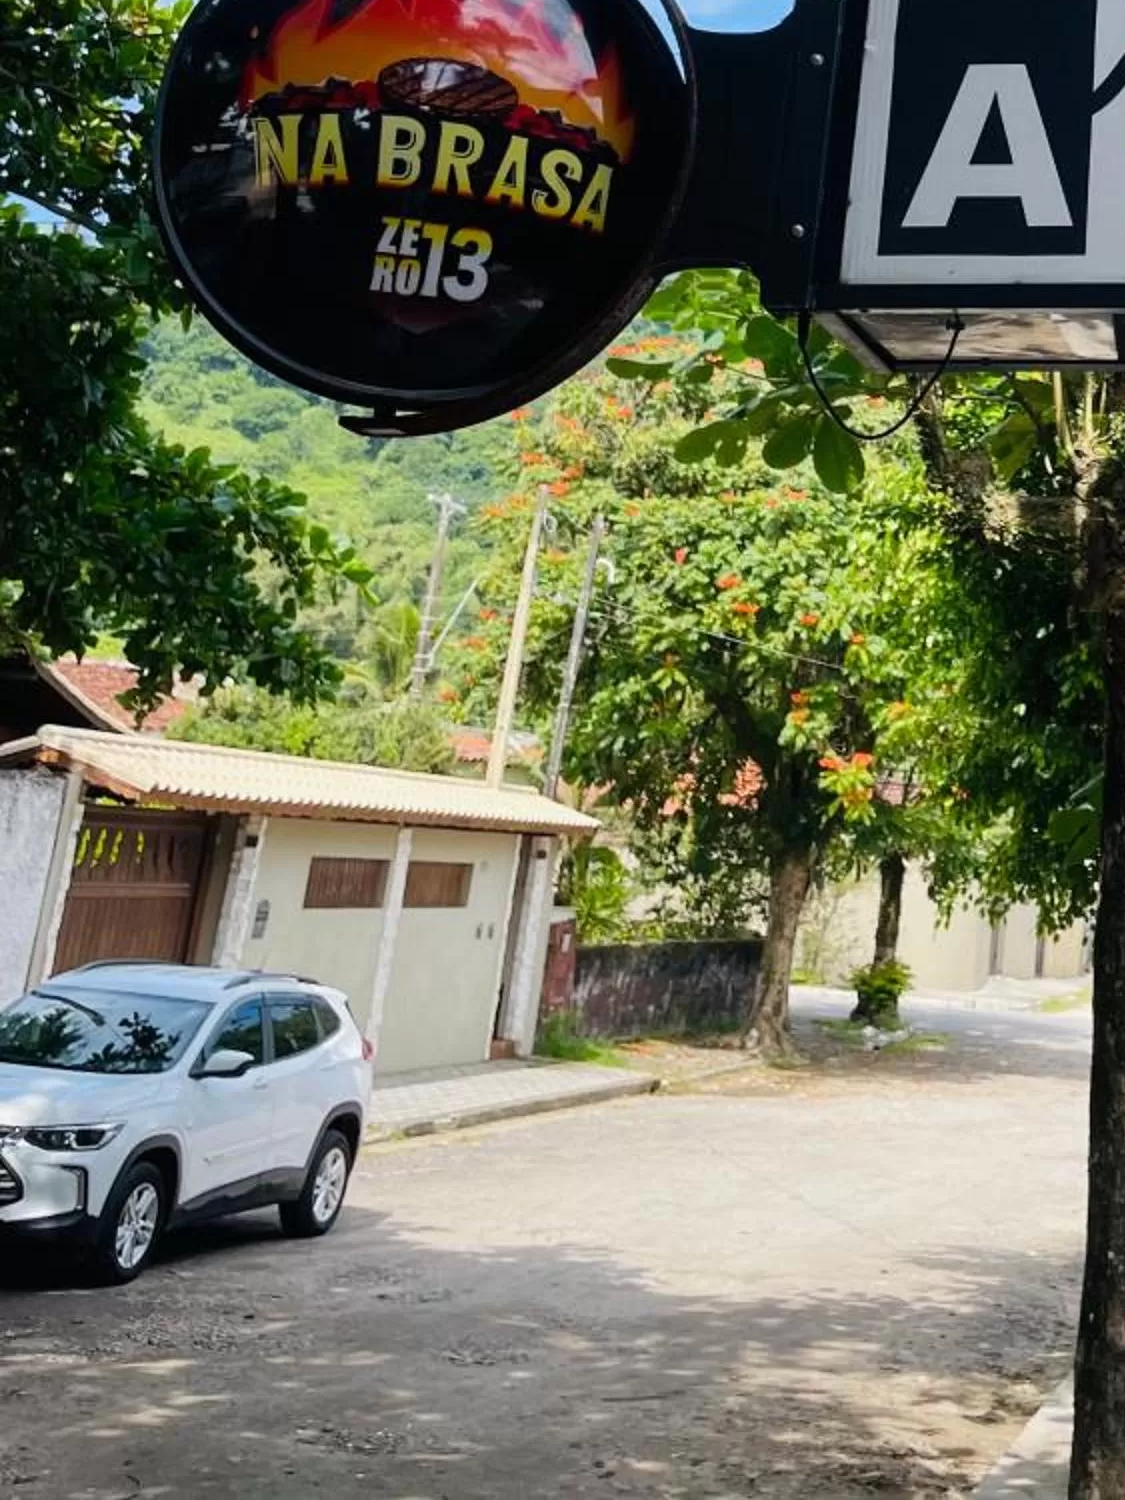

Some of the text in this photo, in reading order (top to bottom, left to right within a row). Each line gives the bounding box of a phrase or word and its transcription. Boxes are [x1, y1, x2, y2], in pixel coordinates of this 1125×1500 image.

[255, 113, 614, 233] NA BRASA
[419, 222, 493, 302] 13
